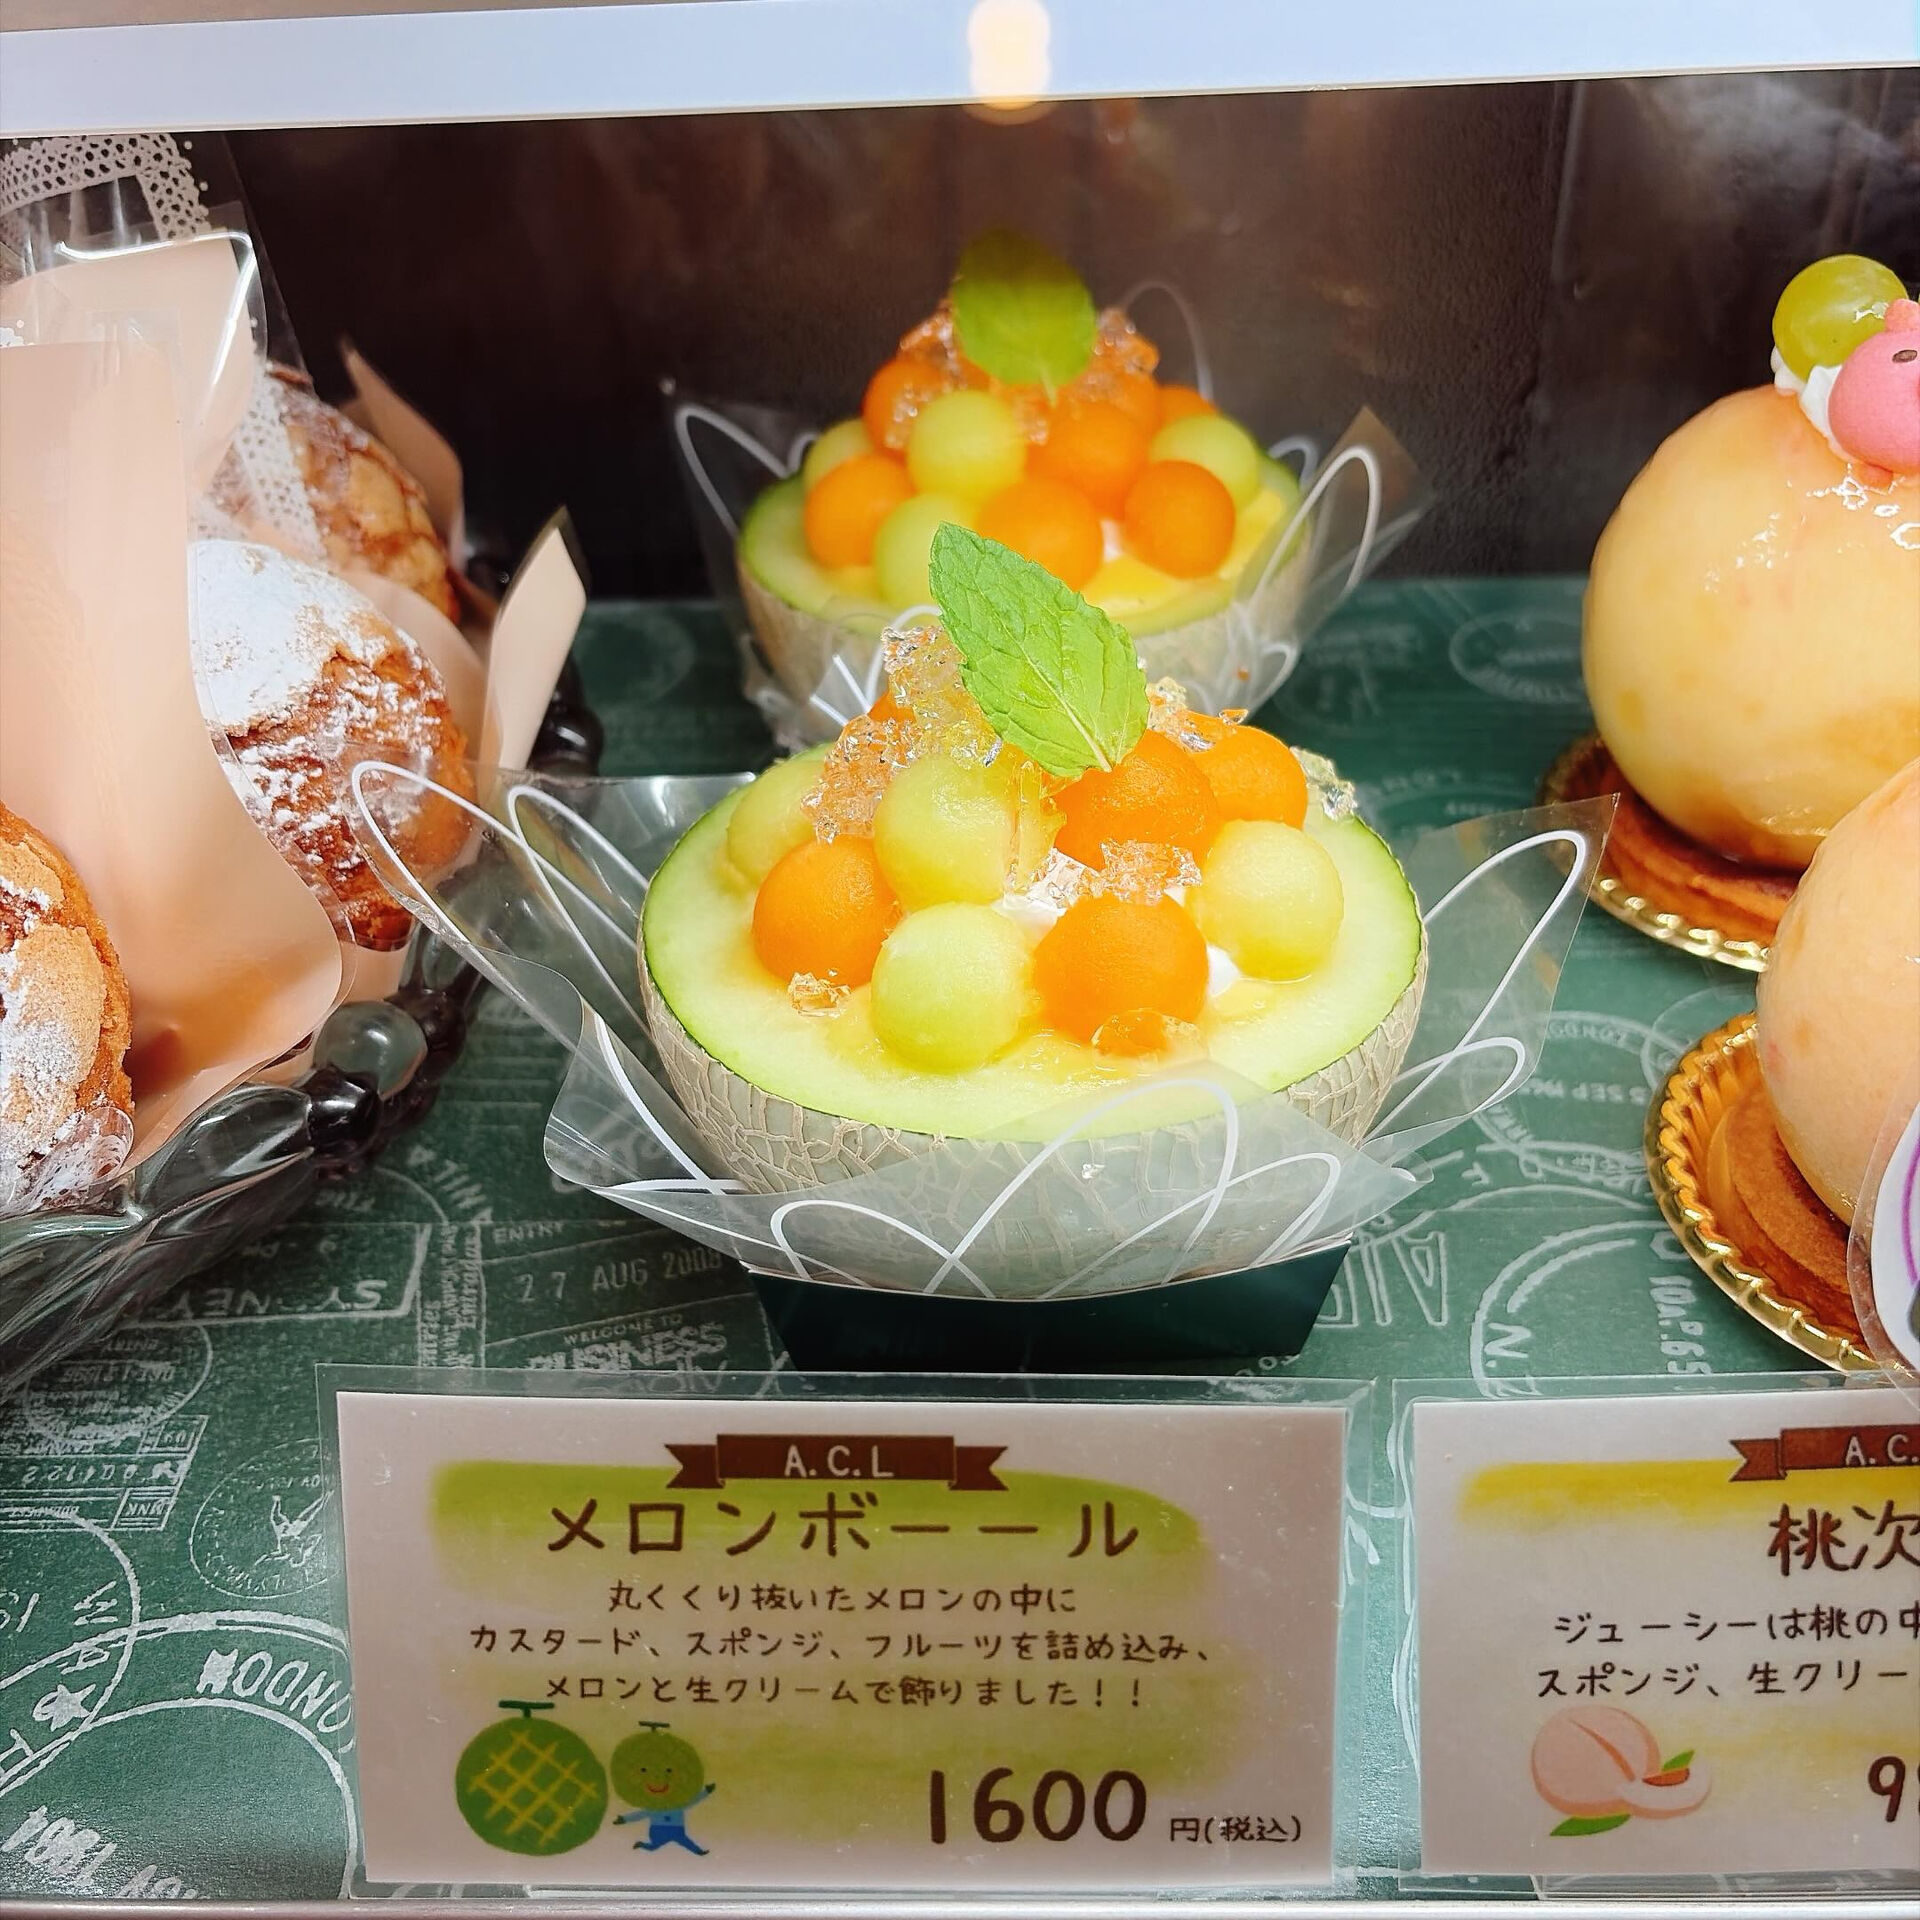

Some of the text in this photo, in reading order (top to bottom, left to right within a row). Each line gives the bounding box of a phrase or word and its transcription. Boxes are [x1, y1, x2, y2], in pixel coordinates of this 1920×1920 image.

[593, 1258, 649, 1292] AUG
[784, 1445, 895, 1478] A.C.L
[608, 1579, 1077, 1616] 丸くくり抜いたメロンの中に
[469, 1624, 1208, 1662] カスタード、スポンジ、フルーツを詰め込み、
[929, 1766, 1147, 1845] 1600
[1868, 1756, 1920, 1823] 9
